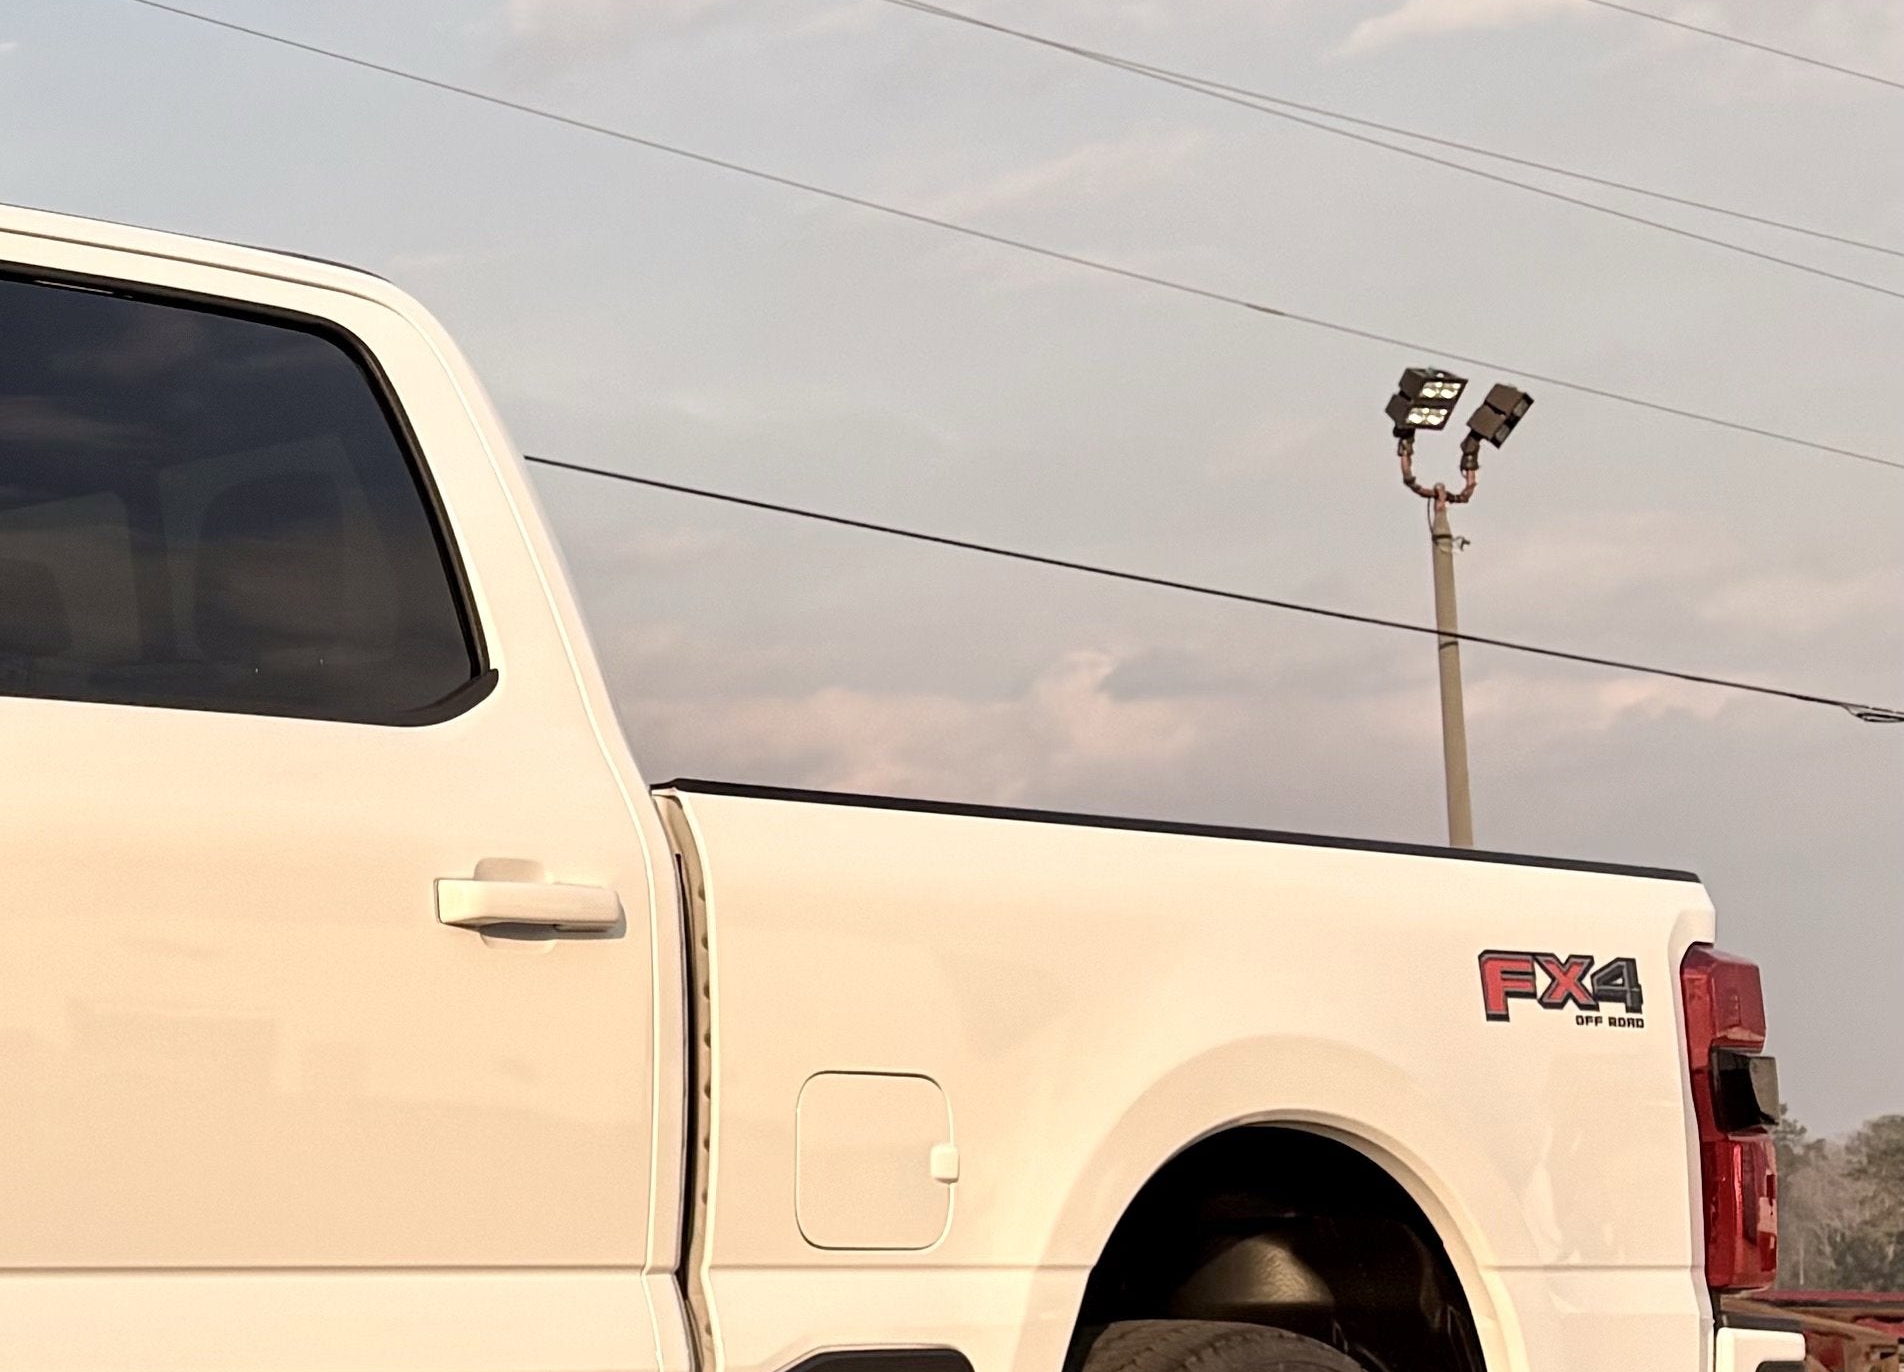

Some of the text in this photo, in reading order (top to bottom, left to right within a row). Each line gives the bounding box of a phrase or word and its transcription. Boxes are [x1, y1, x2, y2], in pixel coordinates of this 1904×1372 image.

[1478, 949, 1644, 1022] FX4
[1576, 1014, 1645, 1029] OFF ROAD
